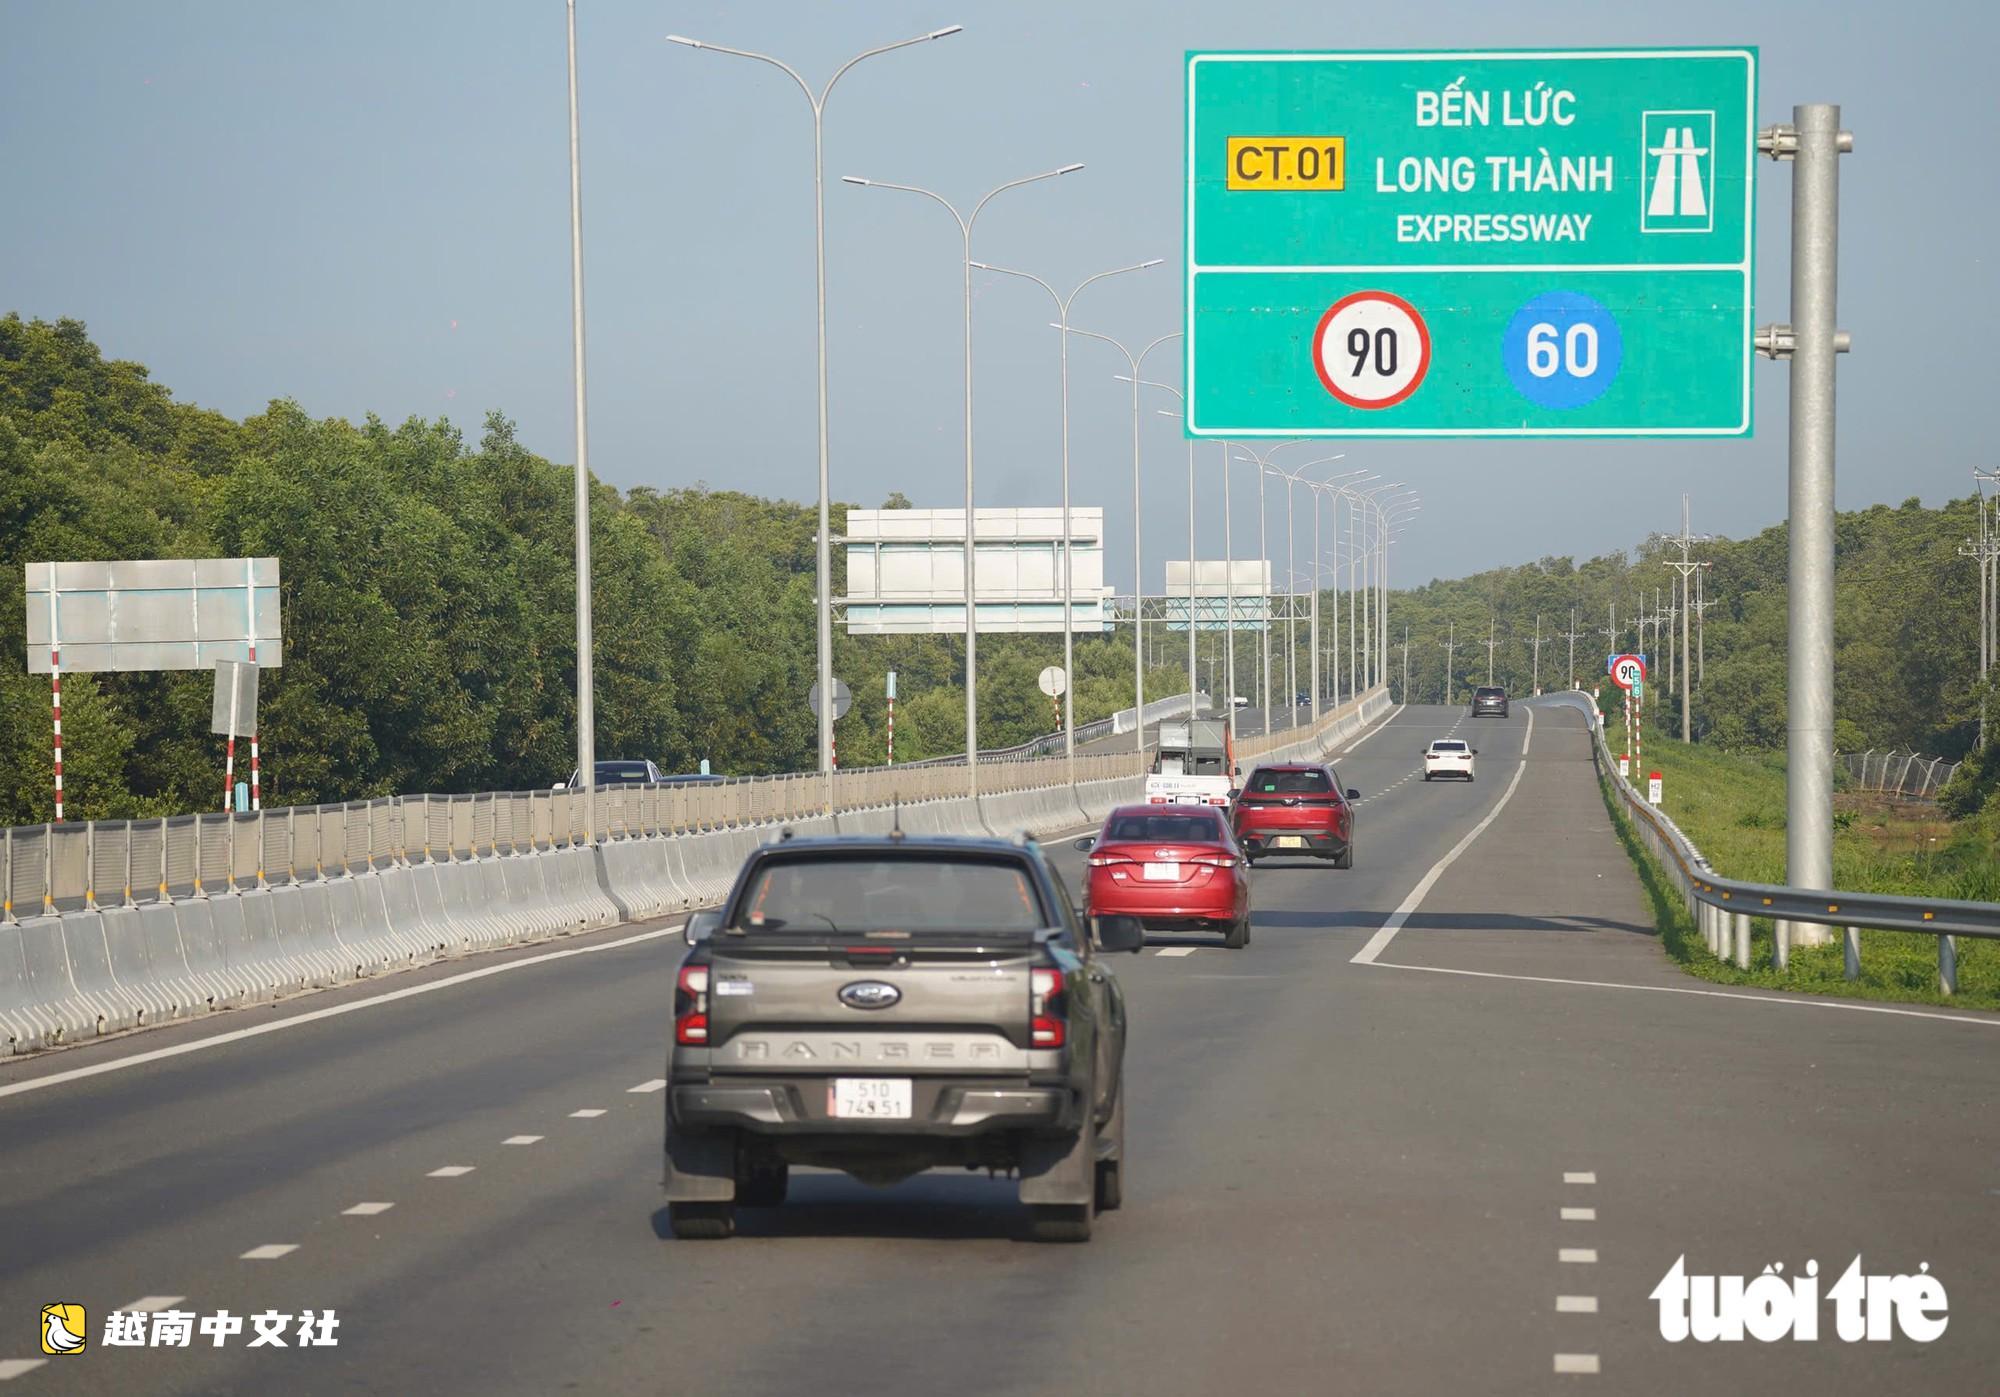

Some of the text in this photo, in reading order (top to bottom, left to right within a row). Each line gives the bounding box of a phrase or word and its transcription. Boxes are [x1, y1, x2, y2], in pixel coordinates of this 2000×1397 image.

[1416, 77, 1576, 127] BẾN LỨC
[1235, 146, 1338, 182] CT.01
[1376, 147, 1613, 193] LONG THÀNH
[1397, 214, 1592, 243] EXPRESSWAY
[1346, 327, 1398, 378] 90
[1526, 322, 1599, 378] 60
[1620, 665, 1635, 680] 90
[736, 1041, 1001, 1061] RANGER
